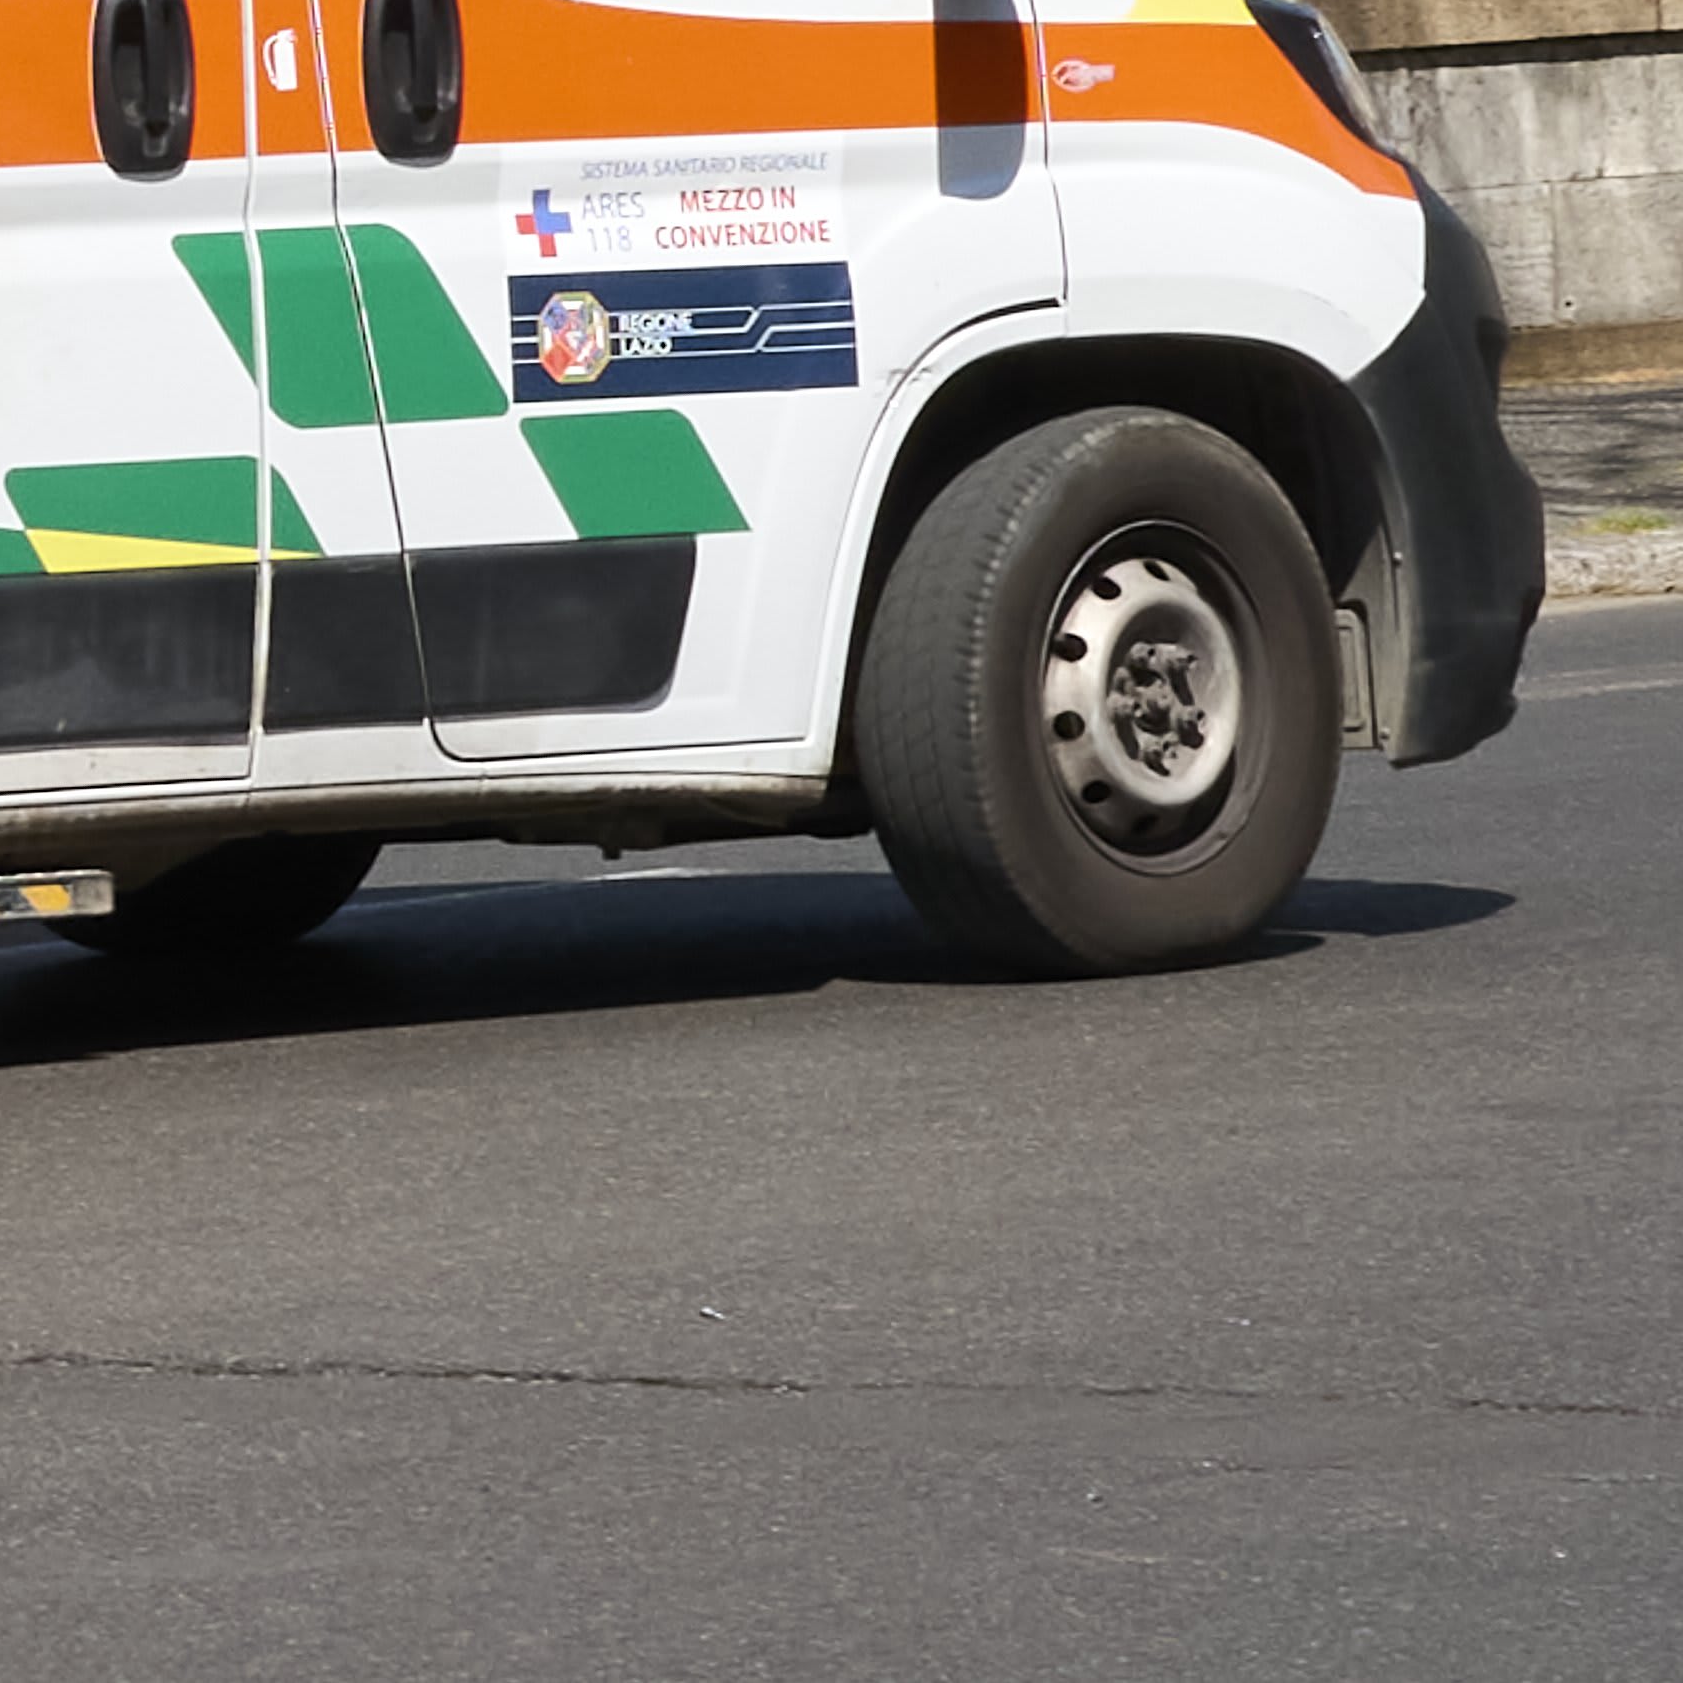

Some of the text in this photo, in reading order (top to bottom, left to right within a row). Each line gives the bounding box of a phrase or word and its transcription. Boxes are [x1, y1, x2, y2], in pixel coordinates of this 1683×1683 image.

[579, 150, 829, 181] SISTEMA SANITARIO REGIONALE
[581, 190, 646, 220] ARES
[679, 185, 797, 214] MEZZO IN
[588, 225, 633, 252] 118
[654, 219, 832, 250] CONVENZIONE
